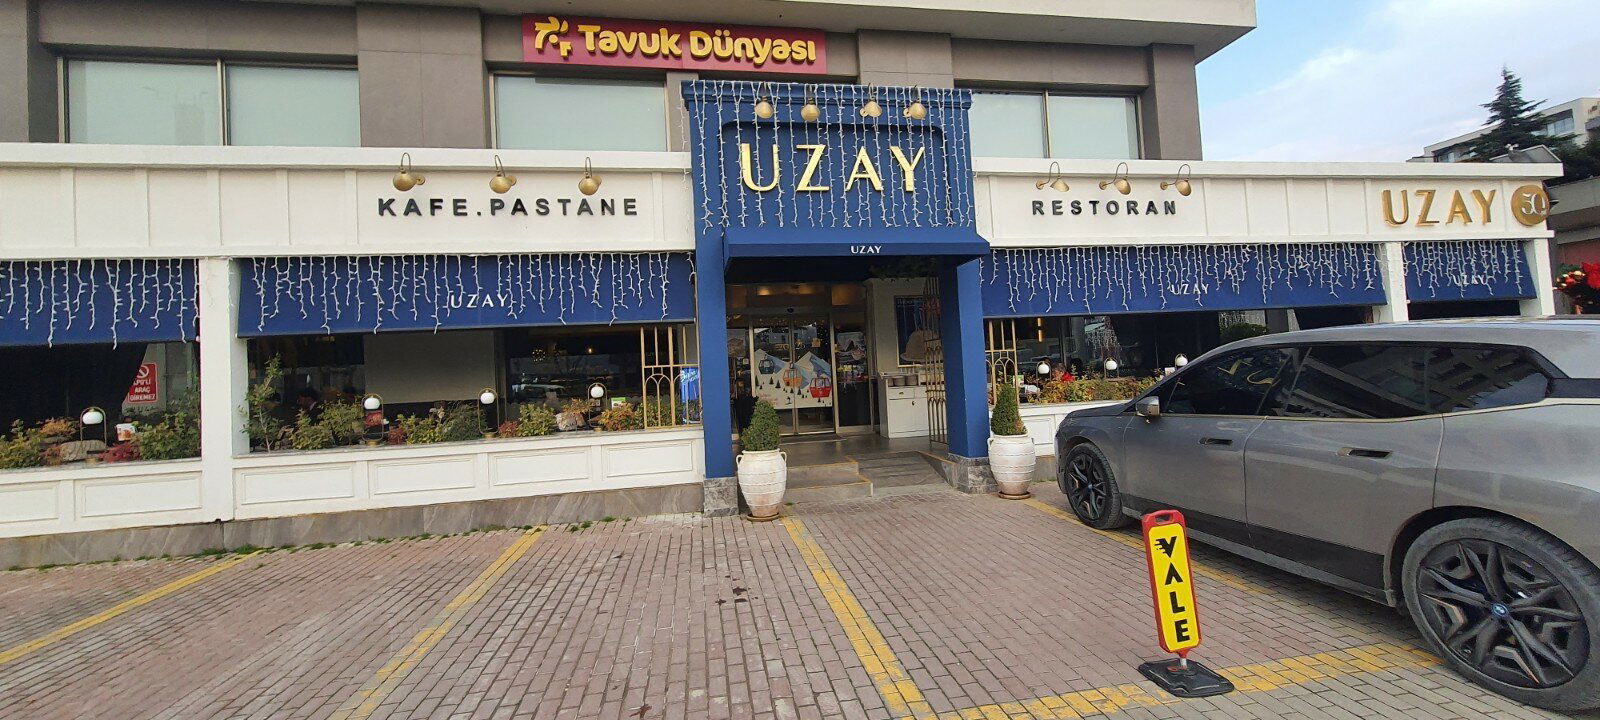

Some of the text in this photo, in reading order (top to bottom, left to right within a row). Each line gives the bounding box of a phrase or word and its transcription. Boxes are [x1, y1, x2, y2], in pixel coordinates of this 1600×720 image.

[577, 24, 817, 65] Tavuk Dünyası
[740, 143, 926, 192] UZAY
[1031, 200, 1177, 216] RESTORAN
[1381, 189, 1497, 226] UZAY
[850, 244, 882, 254] UZAY
[450, 293, 508, 309] UZAY
[1170, 283, 1210, 295] UZAY
[1154, 535, 1191, 643] VALE
